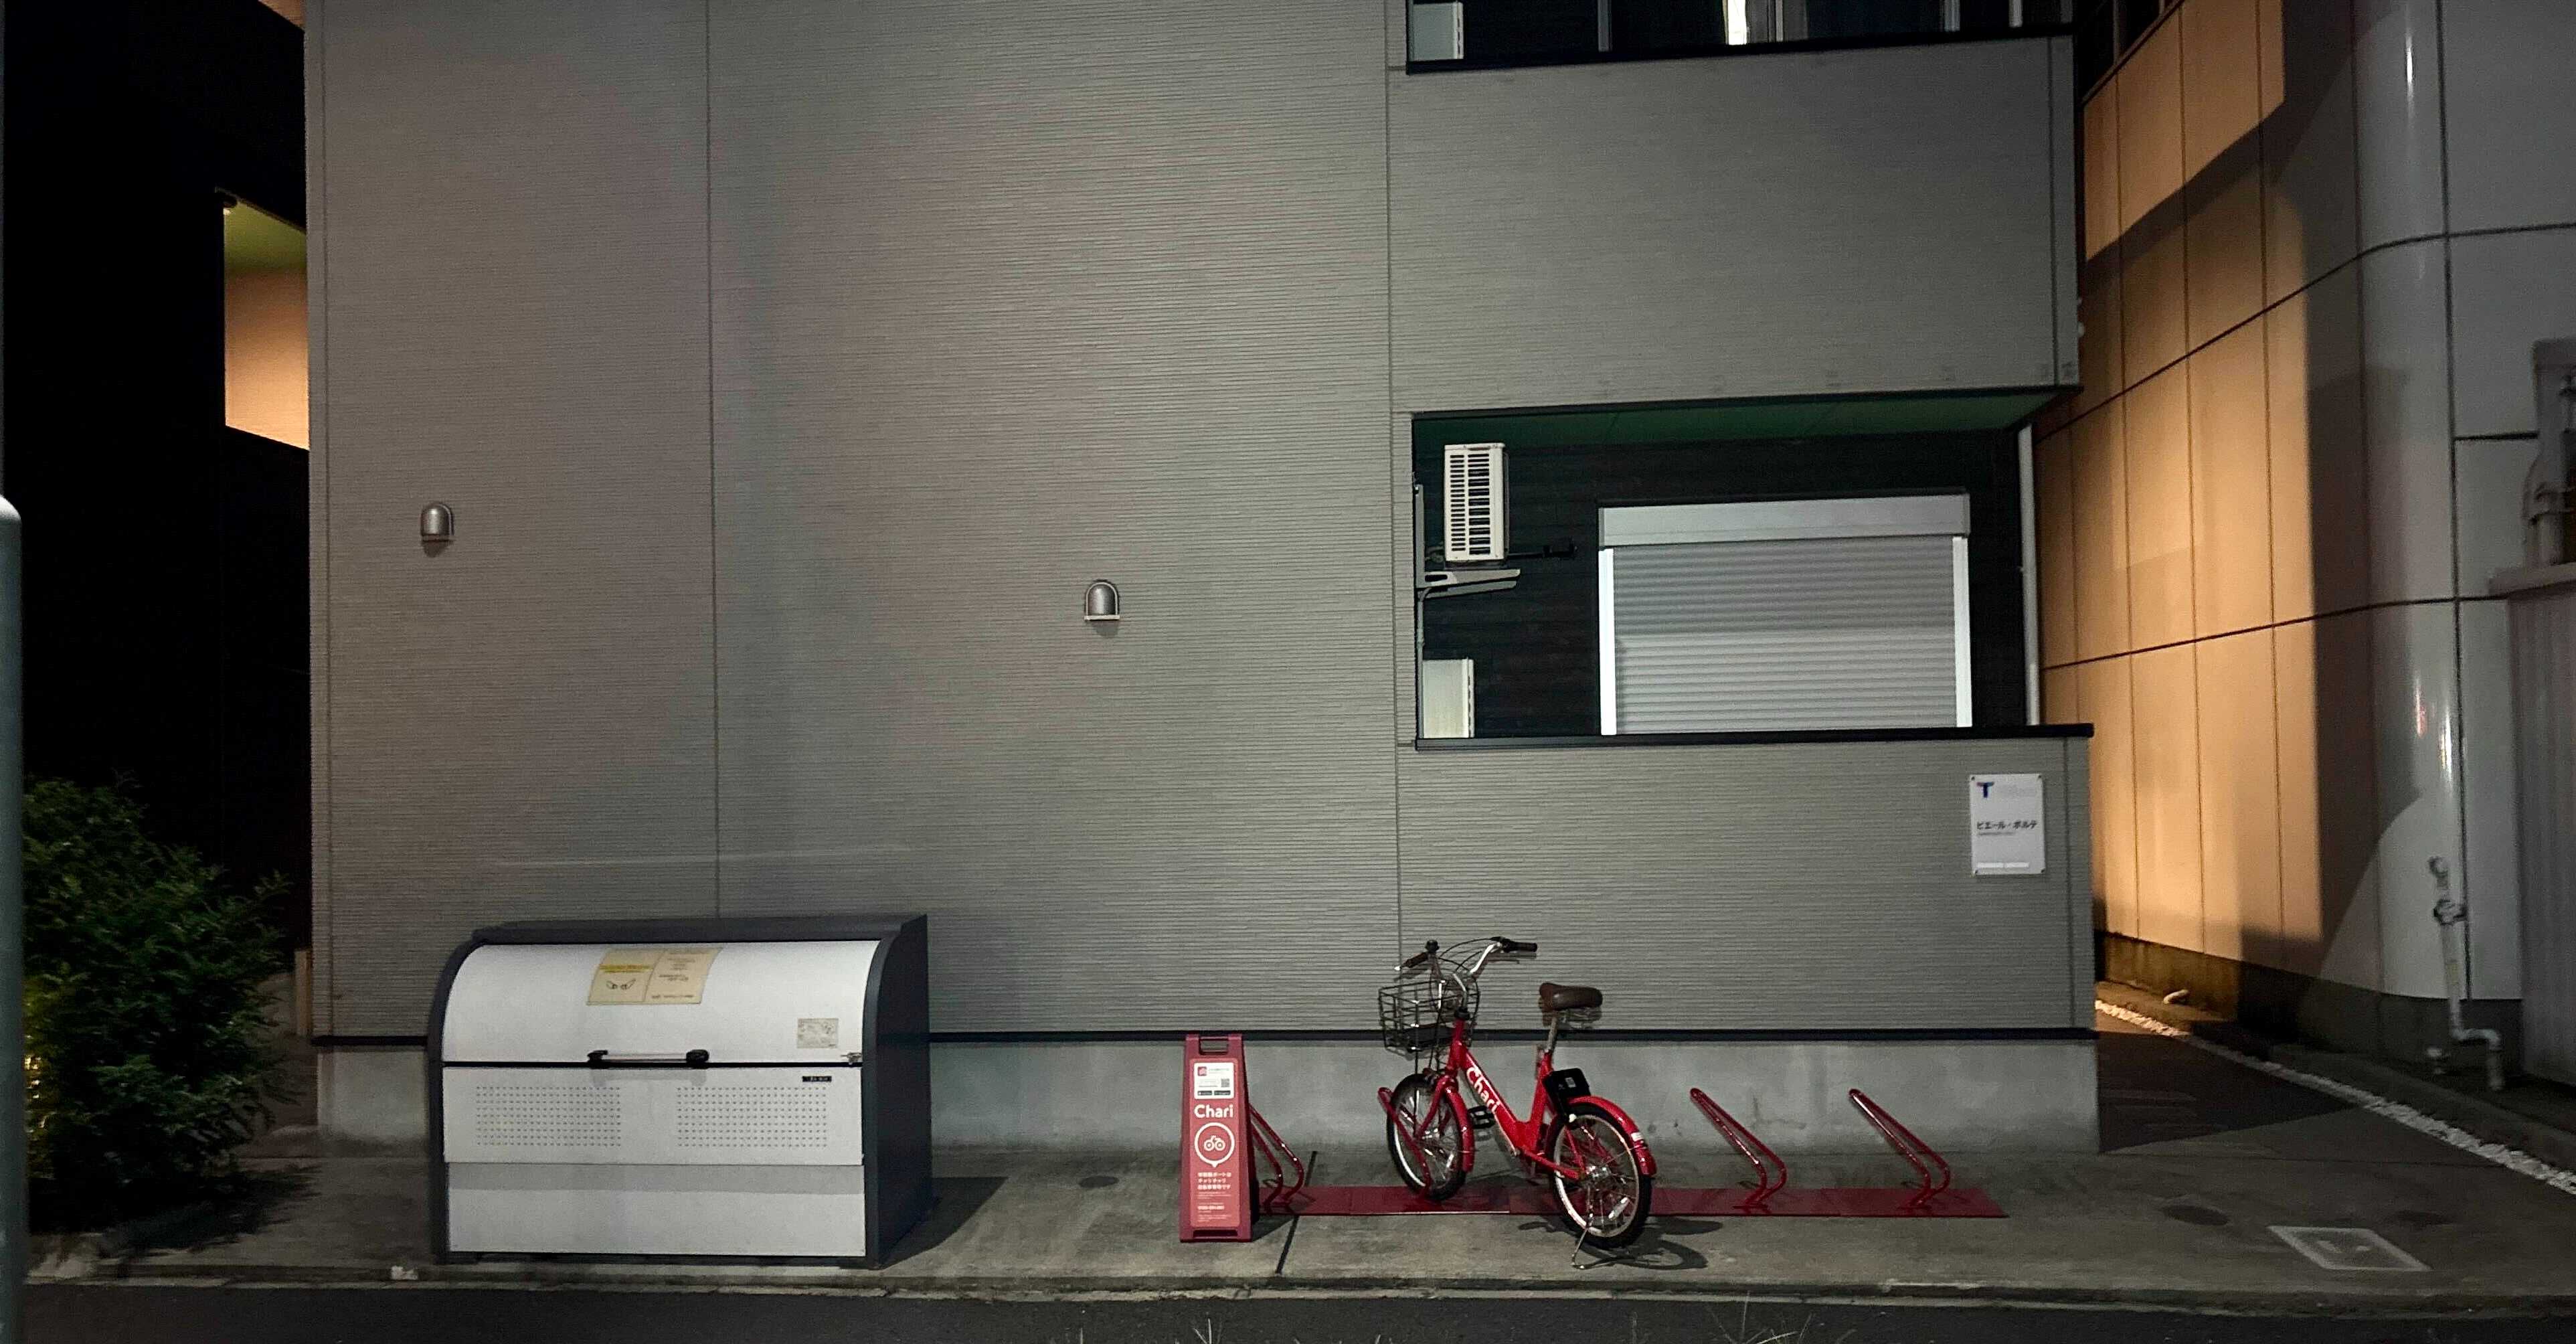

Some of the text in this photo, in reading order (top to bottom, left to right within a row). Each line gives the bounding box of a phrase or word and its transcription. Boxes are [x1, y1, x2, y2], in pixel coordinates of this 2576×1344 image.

[1976, 782, 1994, 798] T
[1466, 1067, 1500, 1114] Chari
[1194, 1104, 1233, 1118] Chari
